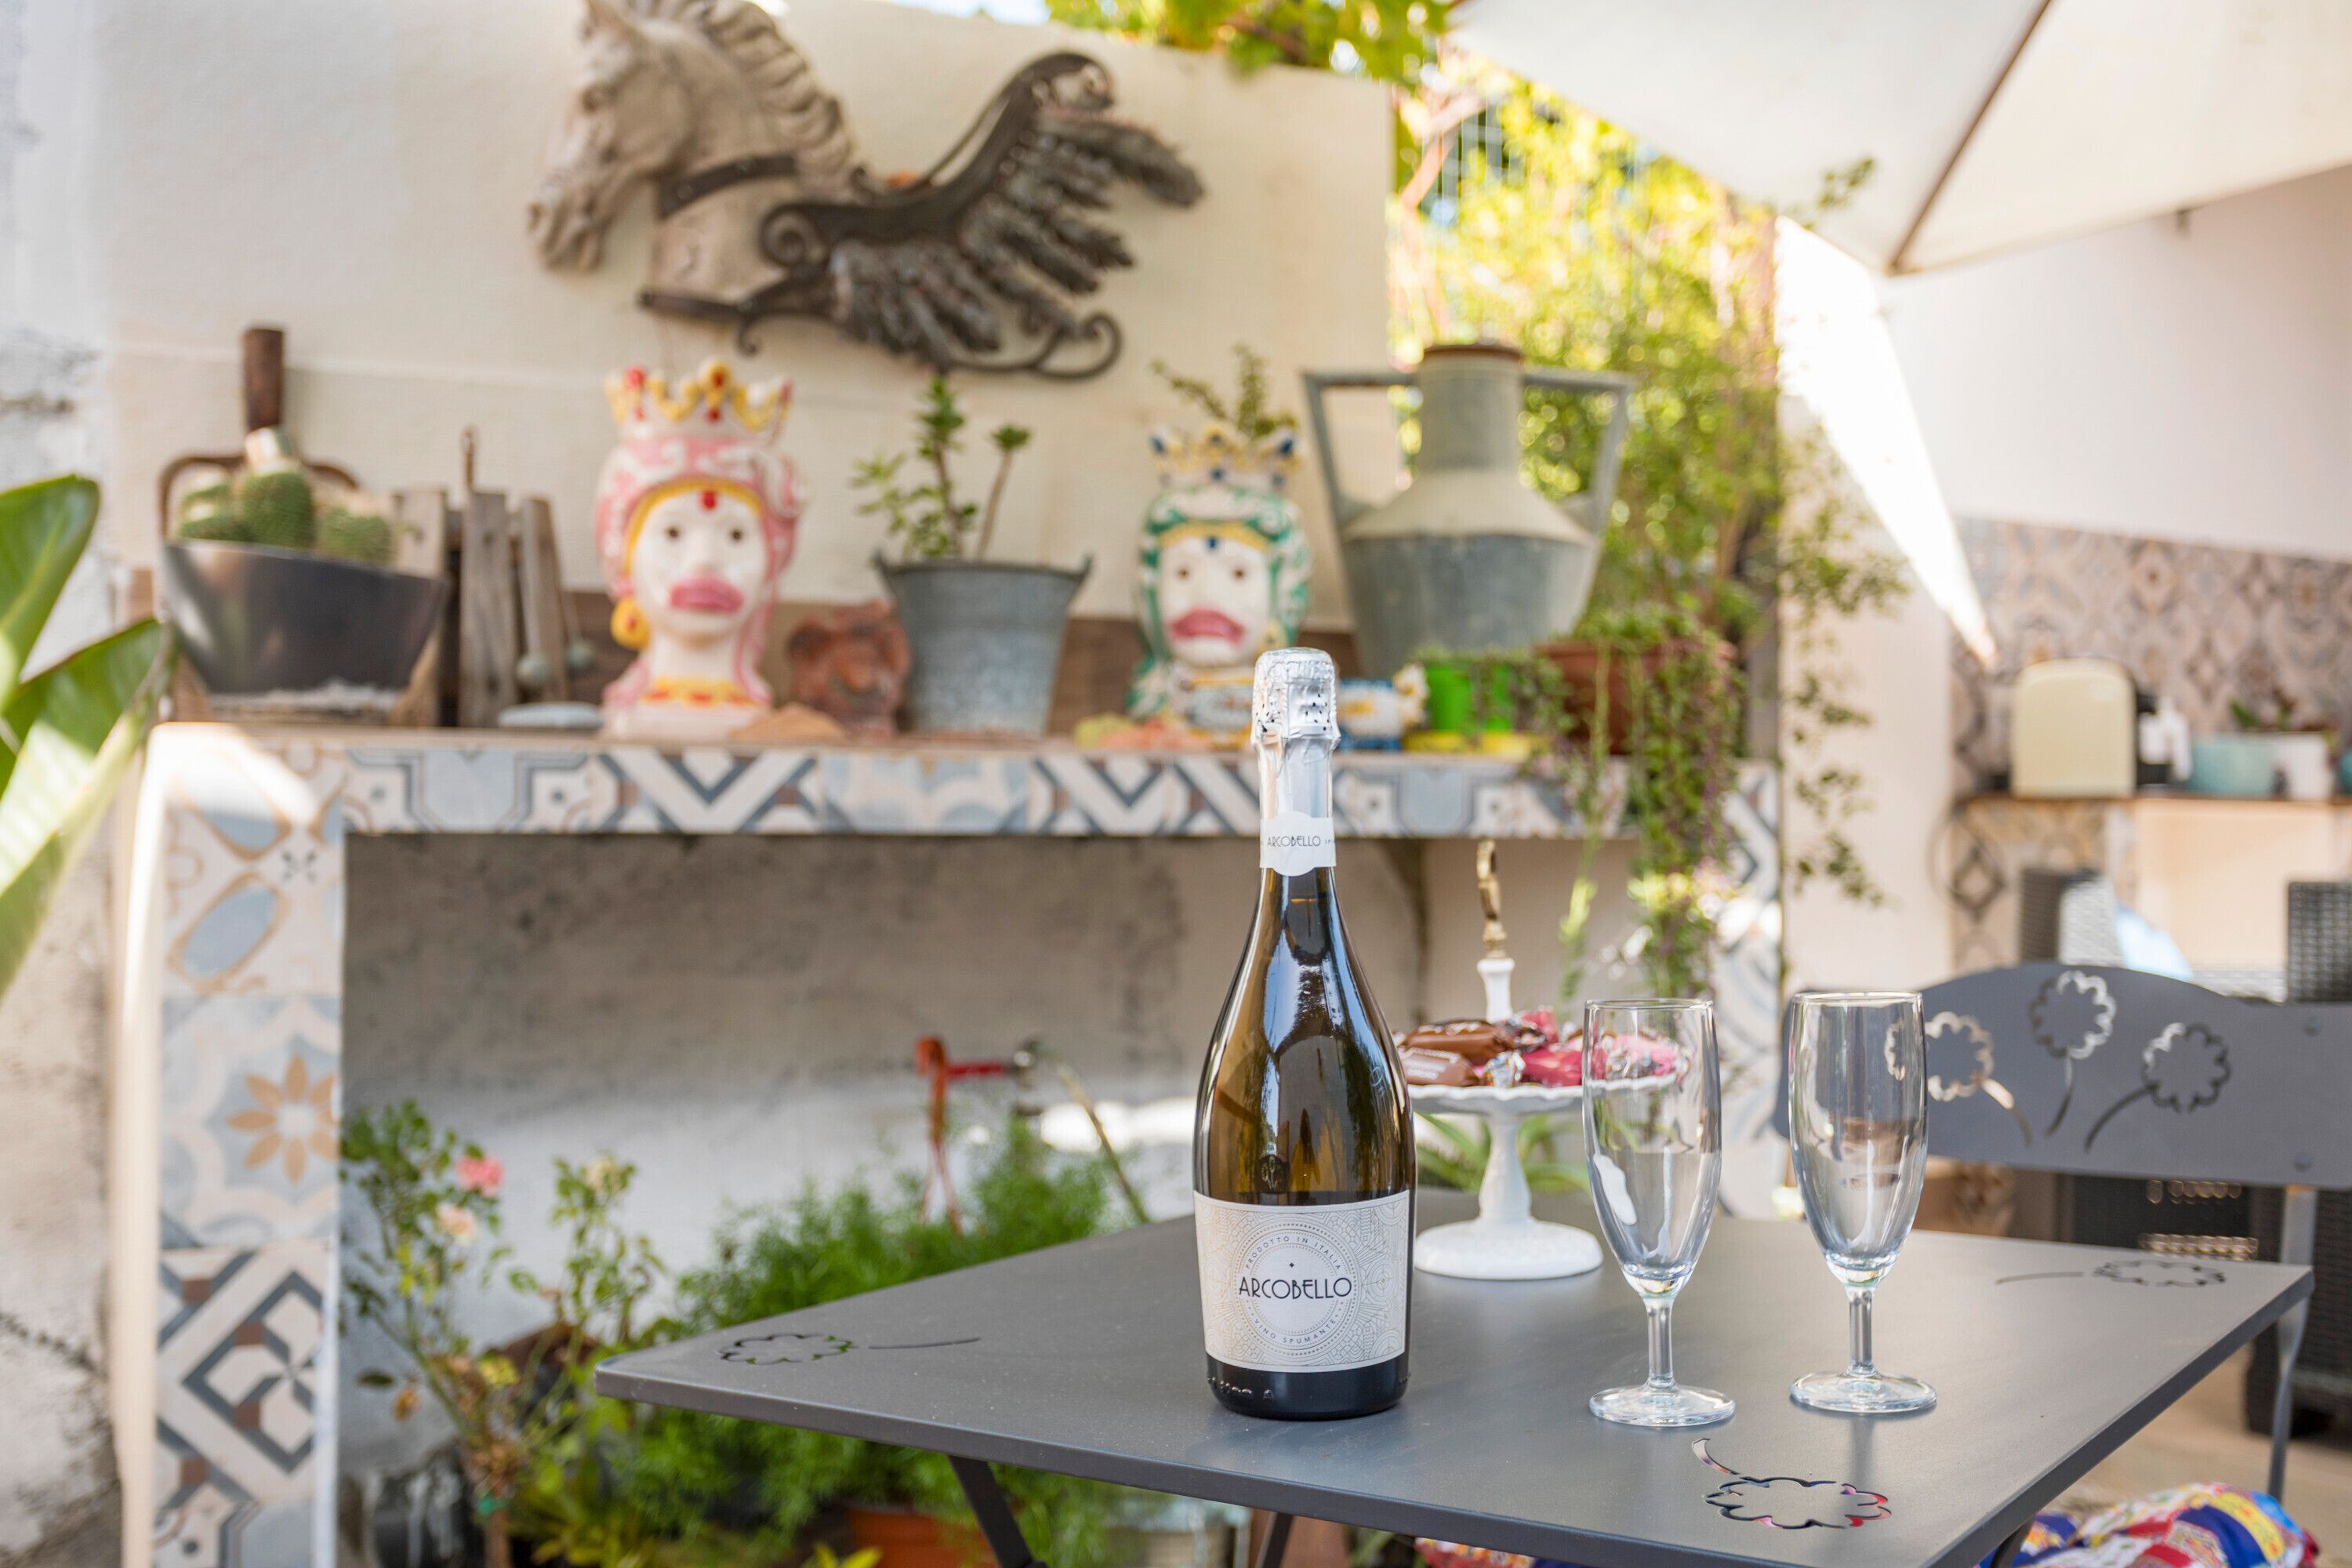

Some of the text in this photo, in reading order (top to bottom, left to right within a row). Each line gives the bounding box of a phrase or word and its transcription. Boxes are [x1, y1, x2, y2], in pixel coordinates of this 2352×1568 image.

[1267, 836, 1321, 848] ARCOBELLO
[1245, 1236, 1290, 1269] PRODOTTO
[1314, 1242, 1341, 1270] ITALIA
[1239, 1276, 1352, 1300] ARCOBELLO
[1254, 1319, 1336, 1344] VINO SPUMANTE
